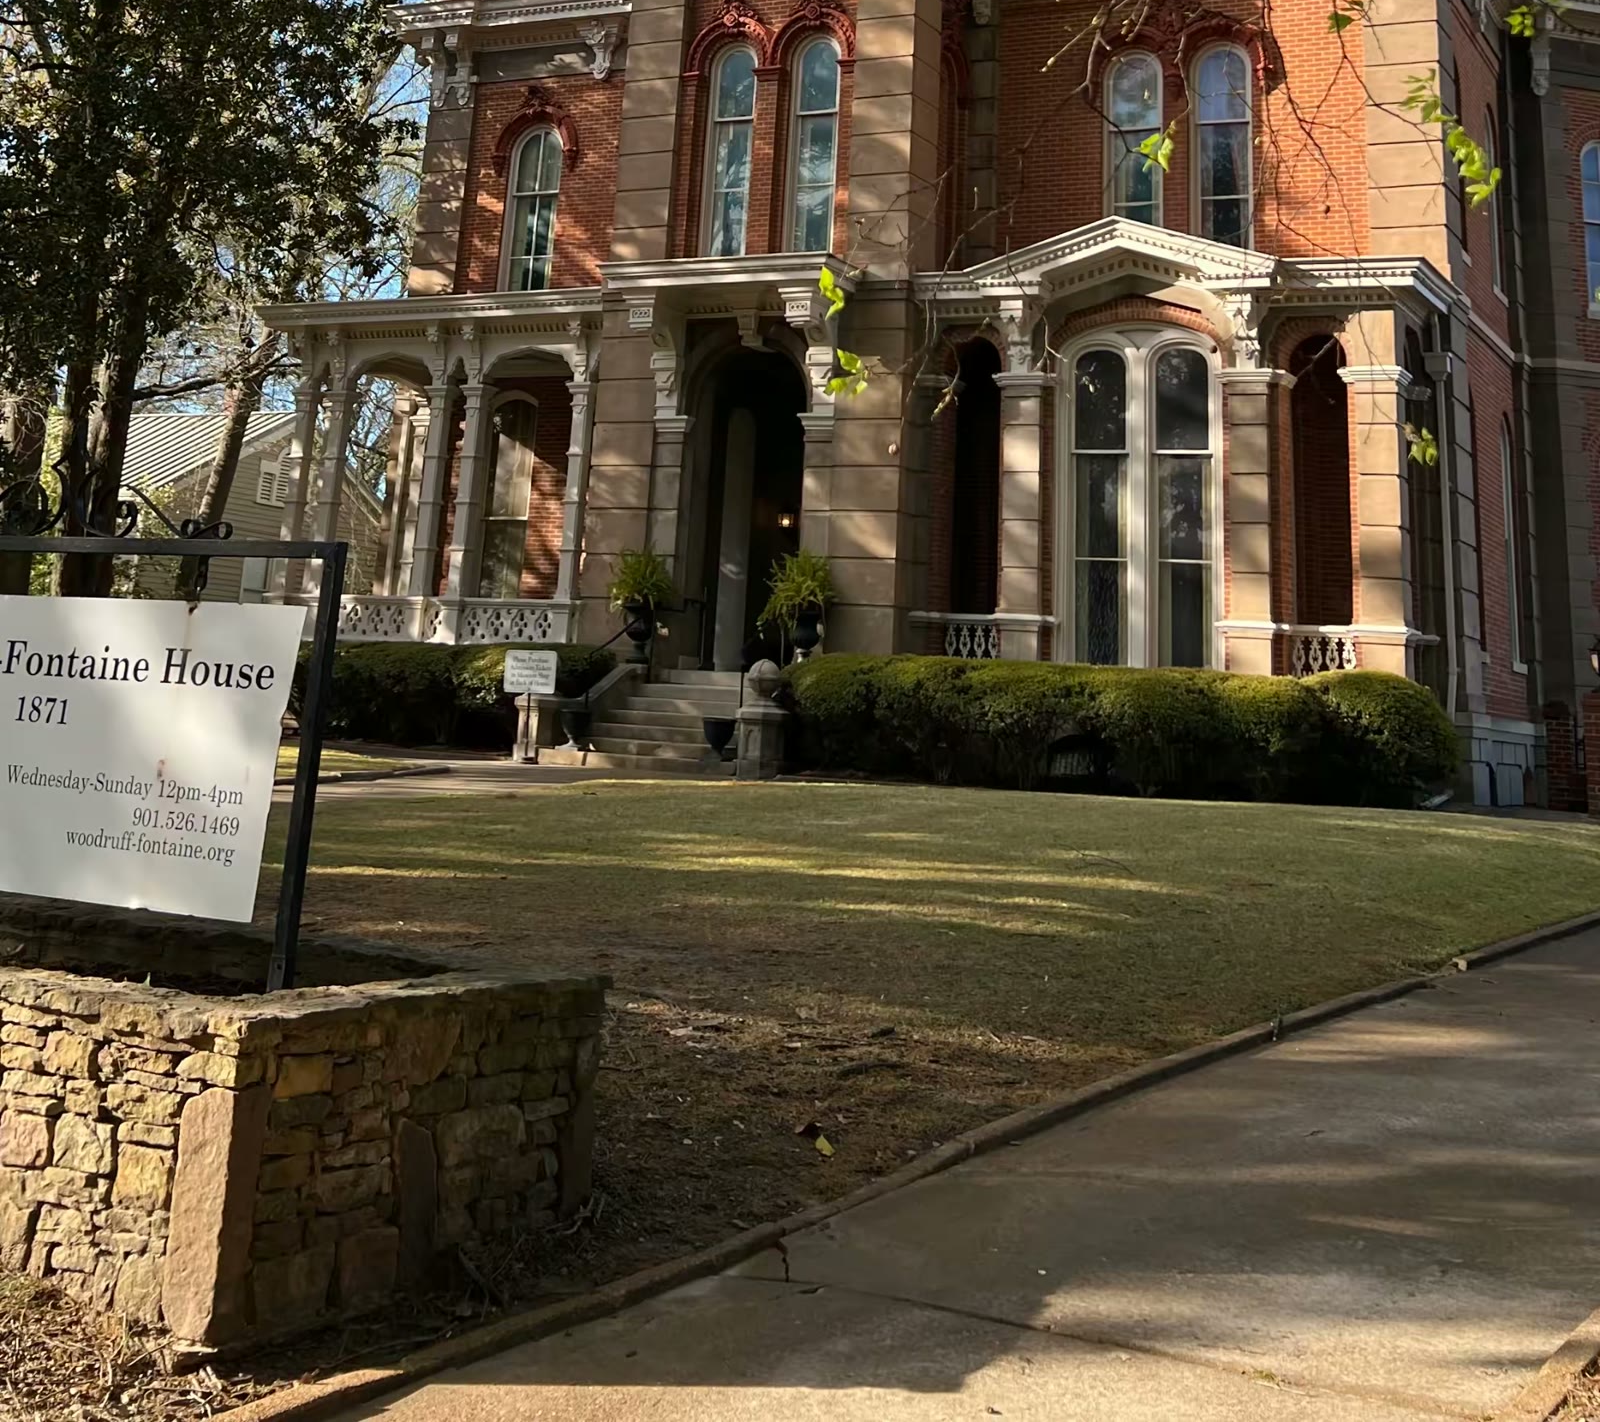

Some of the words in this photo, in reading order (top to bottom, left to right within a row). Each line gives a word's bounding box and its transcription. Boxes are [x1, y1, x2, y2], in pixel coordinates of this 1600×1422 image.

[0, 640, 149, 683] Fontaine
[160, 647, 275, 690] House
[14, 696, 70, 725] 1871
[7, 764, 153, 800] Wednesday-Sunday
[157, 779, 244, 807] 12pm-4pm
[132, 807, 240, 837] 901.526.1469
[66, 828, 236, 867] woodruff-fontaine.org
